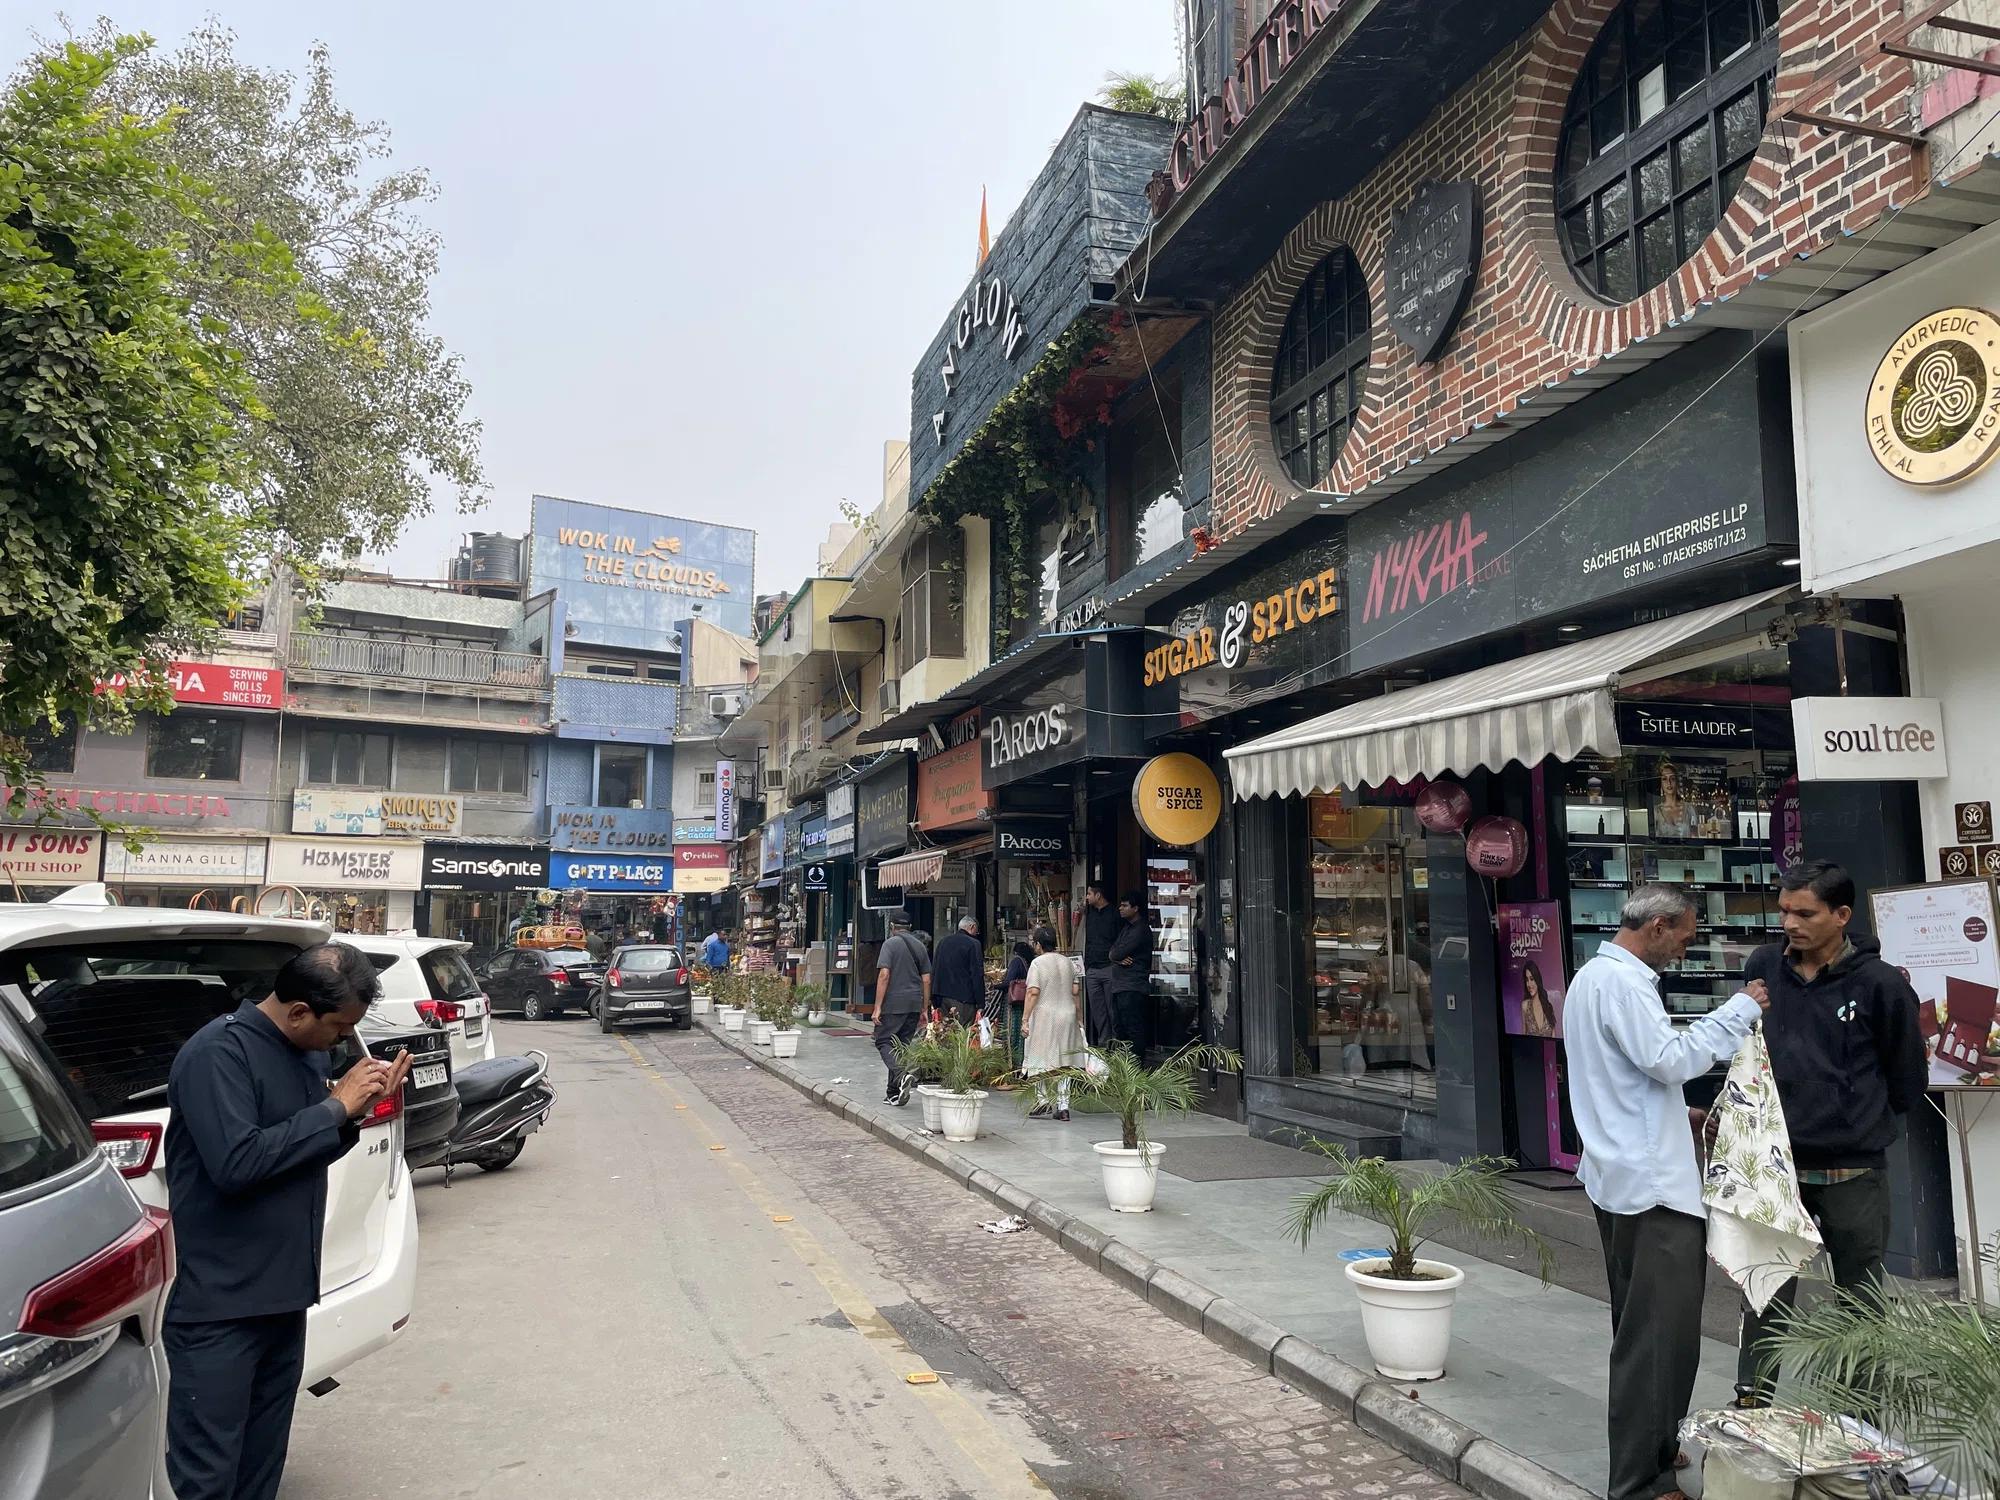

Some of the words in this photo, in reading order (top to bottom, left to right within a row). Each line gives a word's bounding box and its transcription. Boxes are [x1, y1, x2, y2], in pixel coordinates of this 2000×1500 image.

[1891, 316, 1979, 369] AYURVEDIC
[558, 526, 609, 550] WOK
[613, 535, 636, 554] IN
[1582, 540, 1642, 576] SACHETHA
[1643, 511, 1720, 553] ENTERPRISE
[1723, 503, 1748, 526] LLP
[1623, 562, 1641, 579] GST
[1662, 527, 1747, 567] 07AEXFS8617J1Z3
[584, 553, 625, 576] THE
[634, 560, 716, 589] CLOUDS
[1362, 511, 1488, 625] NYKAA
[584, 575, 629, 588] GLOBAL
[1143, 625, 1218, 688] SUGAR
[1219, 600, 1248, 669] &
[1251, 567, 1339, 644] SPICE
[229, 668, 268, 681] SERVING
[233, 681, 263, 692] ROLLS
[222, 691, 249, 704] SINCE
[250, 693, 272, 705] 1972
[990, 703, 1068, 768] PARCOS
[1684, 722, 1737, 737] LAUDER
[1824, 722, 1936, 753] soultree
[720, 768, 733, 832] mamagoto
[1157, 787, 1204, 799] SUGAR
[92, 790, 231, 817] CHACHA
[381, 796, 457, 823] SMOKEYS
[1166, 799, 1204, 811] SPICE
[558, 812, 593, 828] WOK
[600, 814, 616, 828] IN
[25, 833, 93, 855] SONS
[569, 829, 600, 845] THE
[607, 830, 667, 847] CLOUDS
[1000, 833, 1062, 850] PARCOS
[40, 862, 82, 873] SHOP
[135, 854, 194, 865] RANNA
[199, 855, 238, 866] GILL
[431, 858, 542, 878] Samsonite
[341, 865, 390, 879] LONDON
[1509, 918, 1532, 932] PINK
[1510, 932, 1544, 949] FRIDAY
[1509, 942, 1528, 958] Sale
